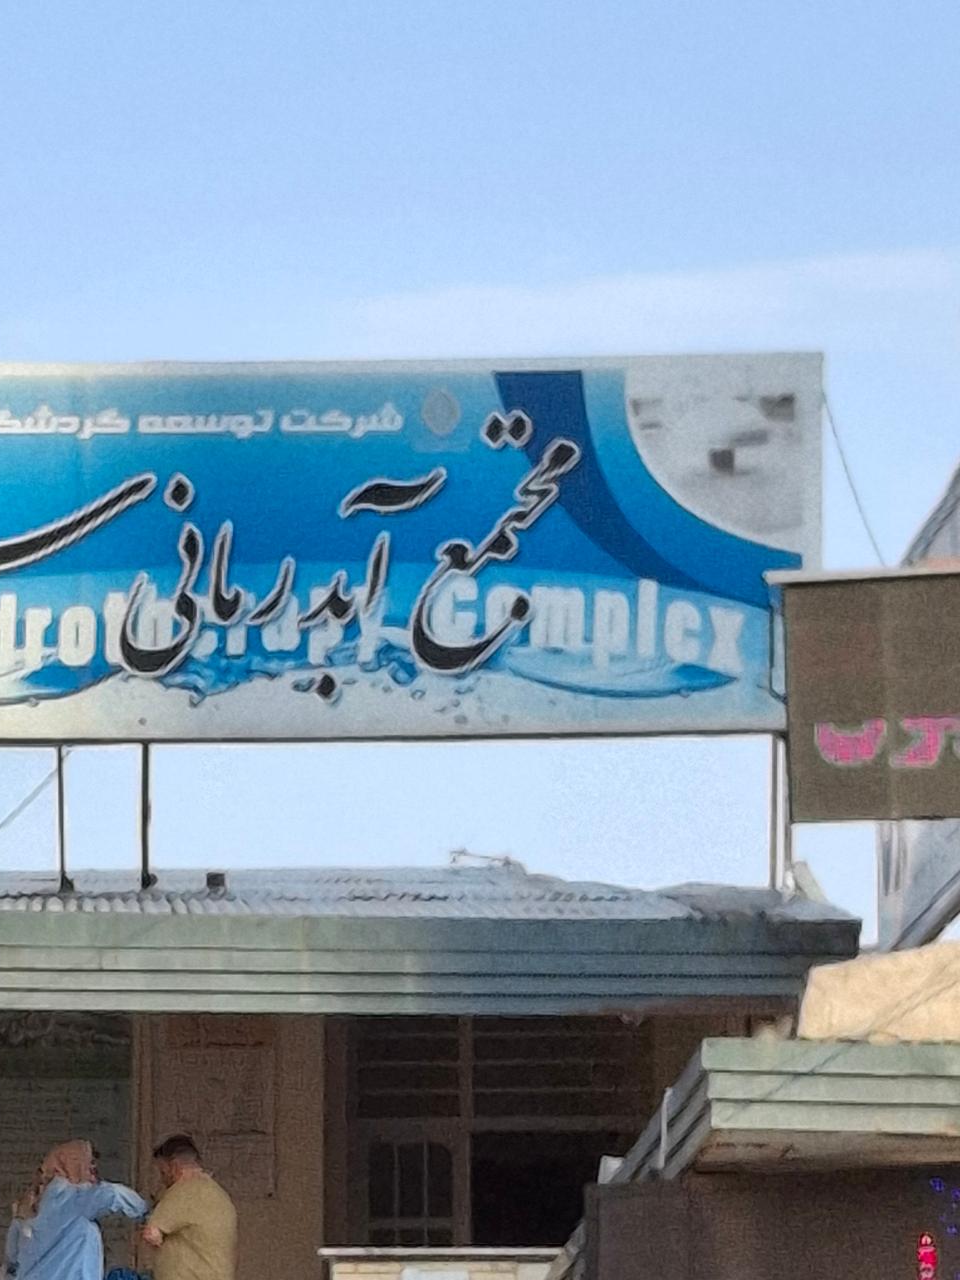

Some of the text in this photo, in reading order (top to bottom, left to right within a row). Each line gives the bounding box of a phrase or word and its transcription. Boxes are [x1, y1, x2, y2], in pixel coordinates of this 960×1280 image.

[138, 408, 275, 439] توسعه
[280, 401, 404, 439] شرکت
[431, 573, 745, 673] Complex
